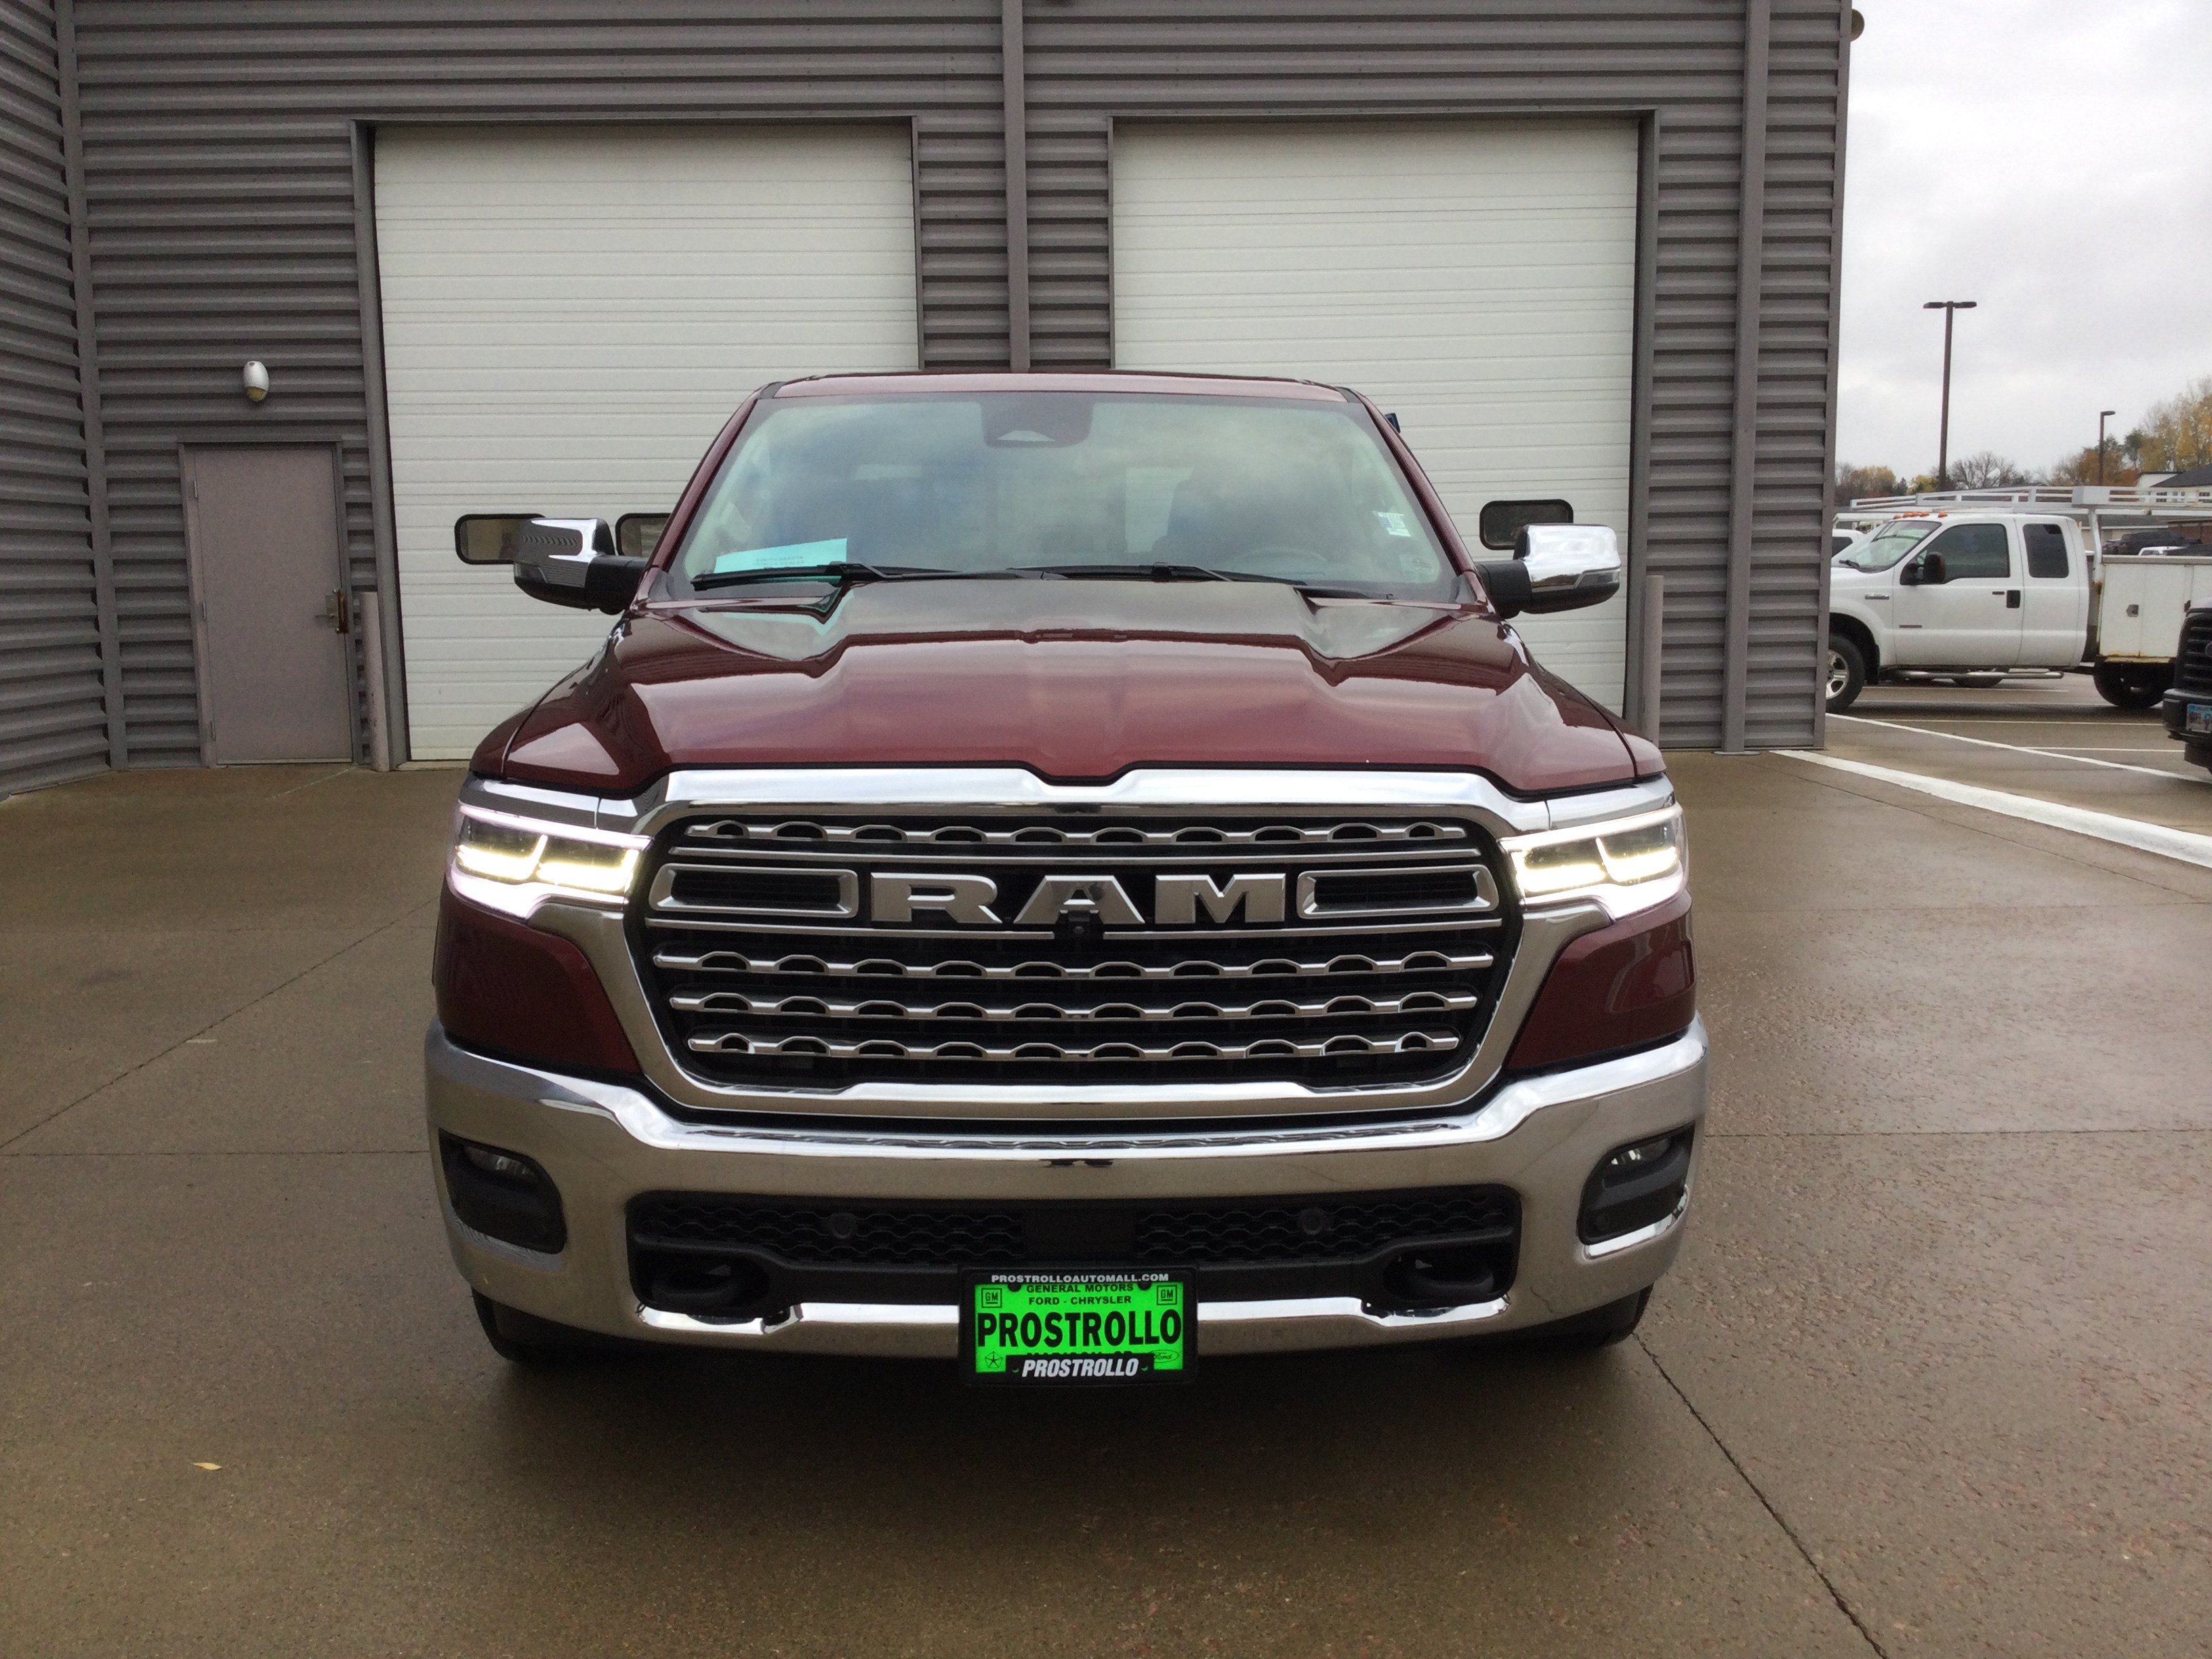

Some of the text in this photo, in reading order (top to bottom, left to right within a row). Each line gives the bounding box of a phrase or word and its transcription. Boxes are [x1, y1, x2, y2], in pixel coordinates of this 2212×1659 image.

[871, 872, 1286, 924] RAM
[991, 1273, 1169, 1283] PROSTROLLOAUTOMALL.COM
[1026, 1283, 1134, 1293] GENERAL MOTORS
[985, 1292, 998, 1301] GM
[1160, 1289, 1174, 1298] GM
[1029, 1296, 1060, 1305] FORD
[1071, 1295, 1132, 1305] CHRYSLER
[977, 1309, 1182, 1348] PROSTROLLO
[1153, 1352, 1173, 1360] Ford
[1022, 1358, 1139, 1378] PROSTROLLO
